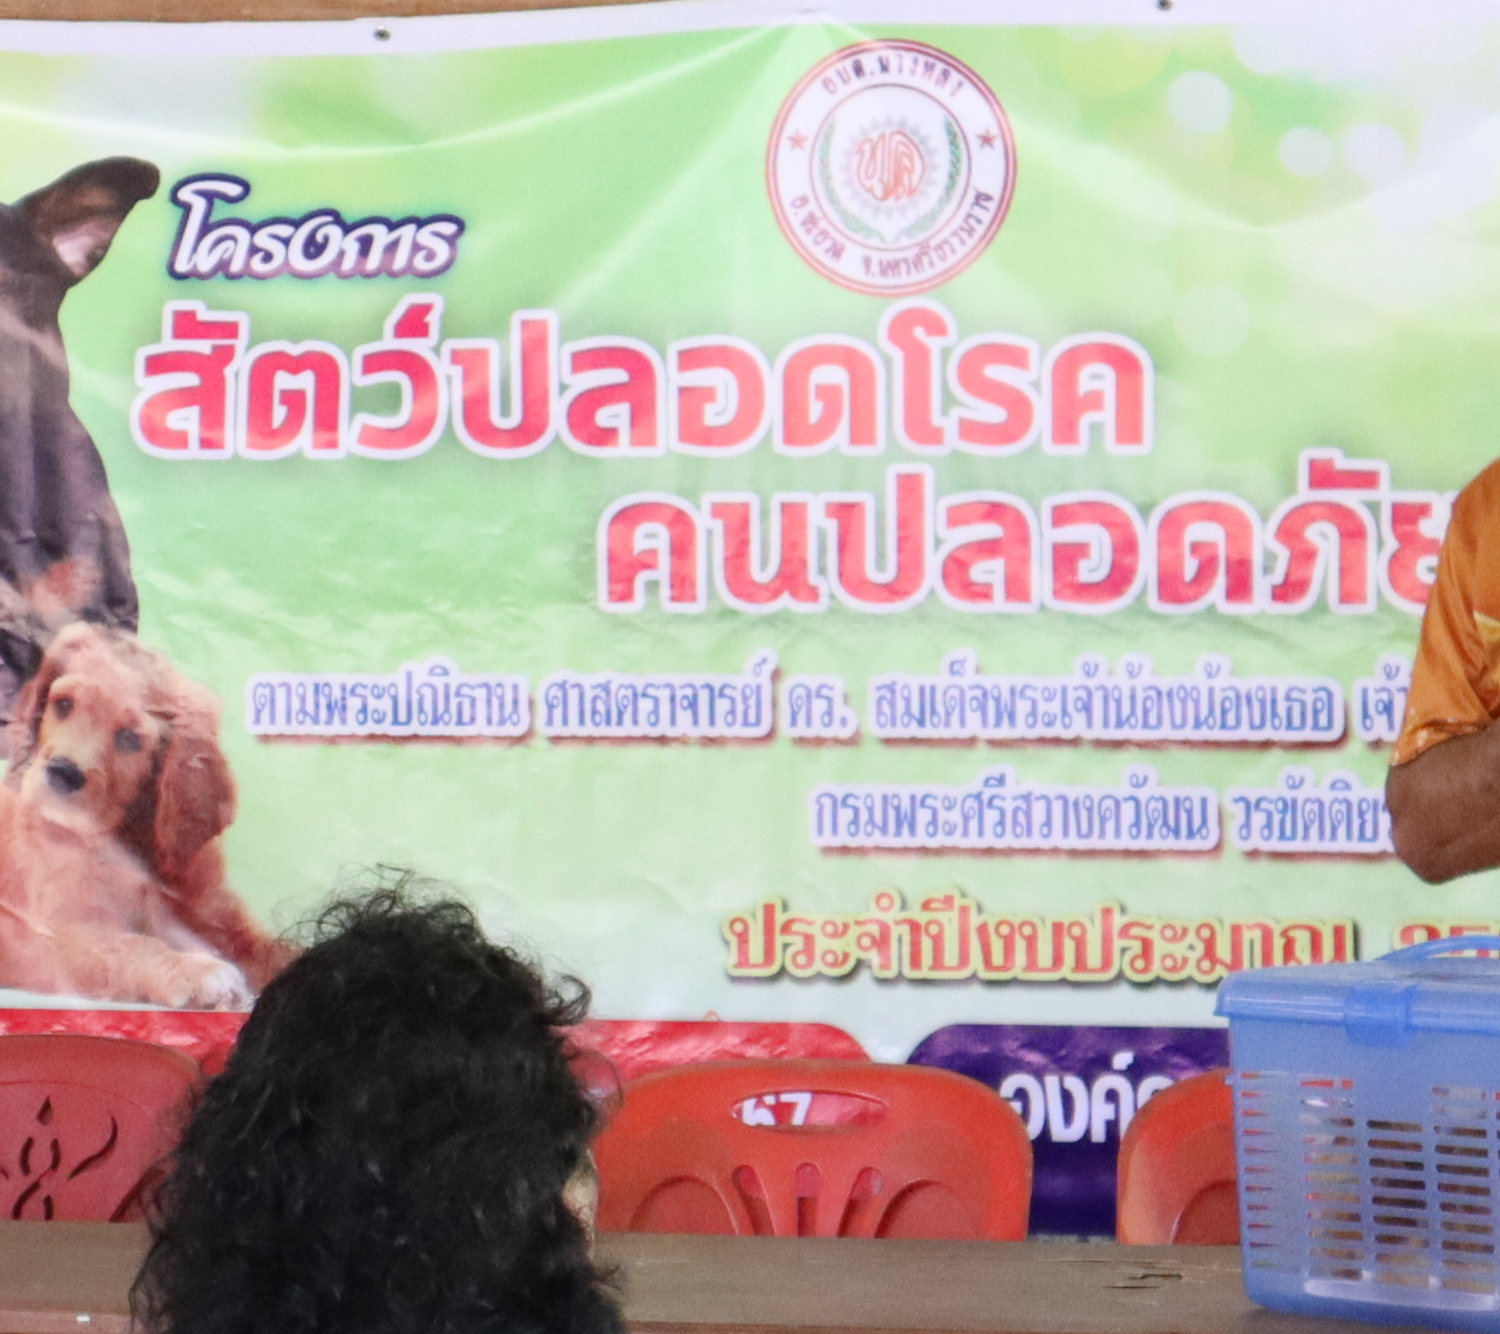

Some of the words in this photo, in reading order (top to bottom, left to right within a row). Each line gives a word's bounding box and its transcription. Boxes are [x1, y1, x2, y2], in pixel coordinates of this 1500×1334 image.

[172, 177, 464, 277] โครงการ
[136, 305, 1148, 457] สัตว์ปลอดโรค
[251, 670, 522, 732] ตามพระปณิธาน
[543, 652, 768, 729] ศาสตราจารย์
[790, 684, 848, 730] ดร.
